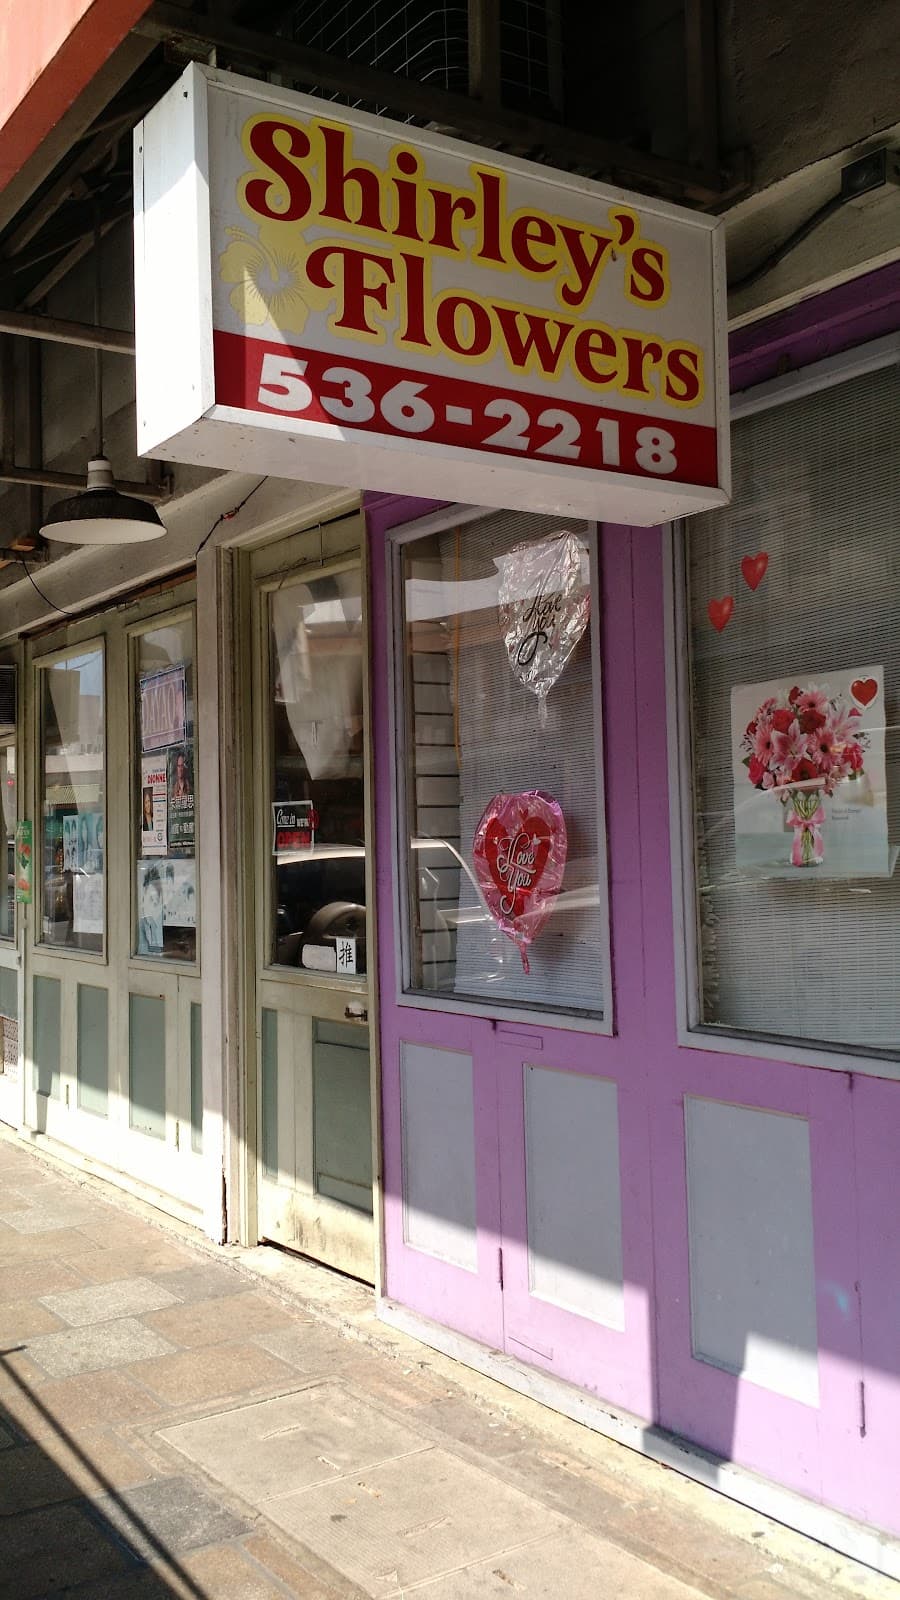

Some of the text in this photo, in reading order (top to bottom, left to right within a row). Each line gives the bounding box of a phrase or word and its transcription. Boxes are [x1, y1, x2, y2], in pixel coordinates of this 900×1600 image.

[244, 120, 671, 307] Shirley's
[305, 246, 702, 403] Flowers
[257, 353, 679, 475] 536-2218
[276, 808, 290, 825] Come
[289, 812, 296, 825] in
[276, 831, 311, 848] OPEN
[496, 832, 537, 874] Love
[499, 866, 533, 915] You
[338, 940, 354, 969] 推
